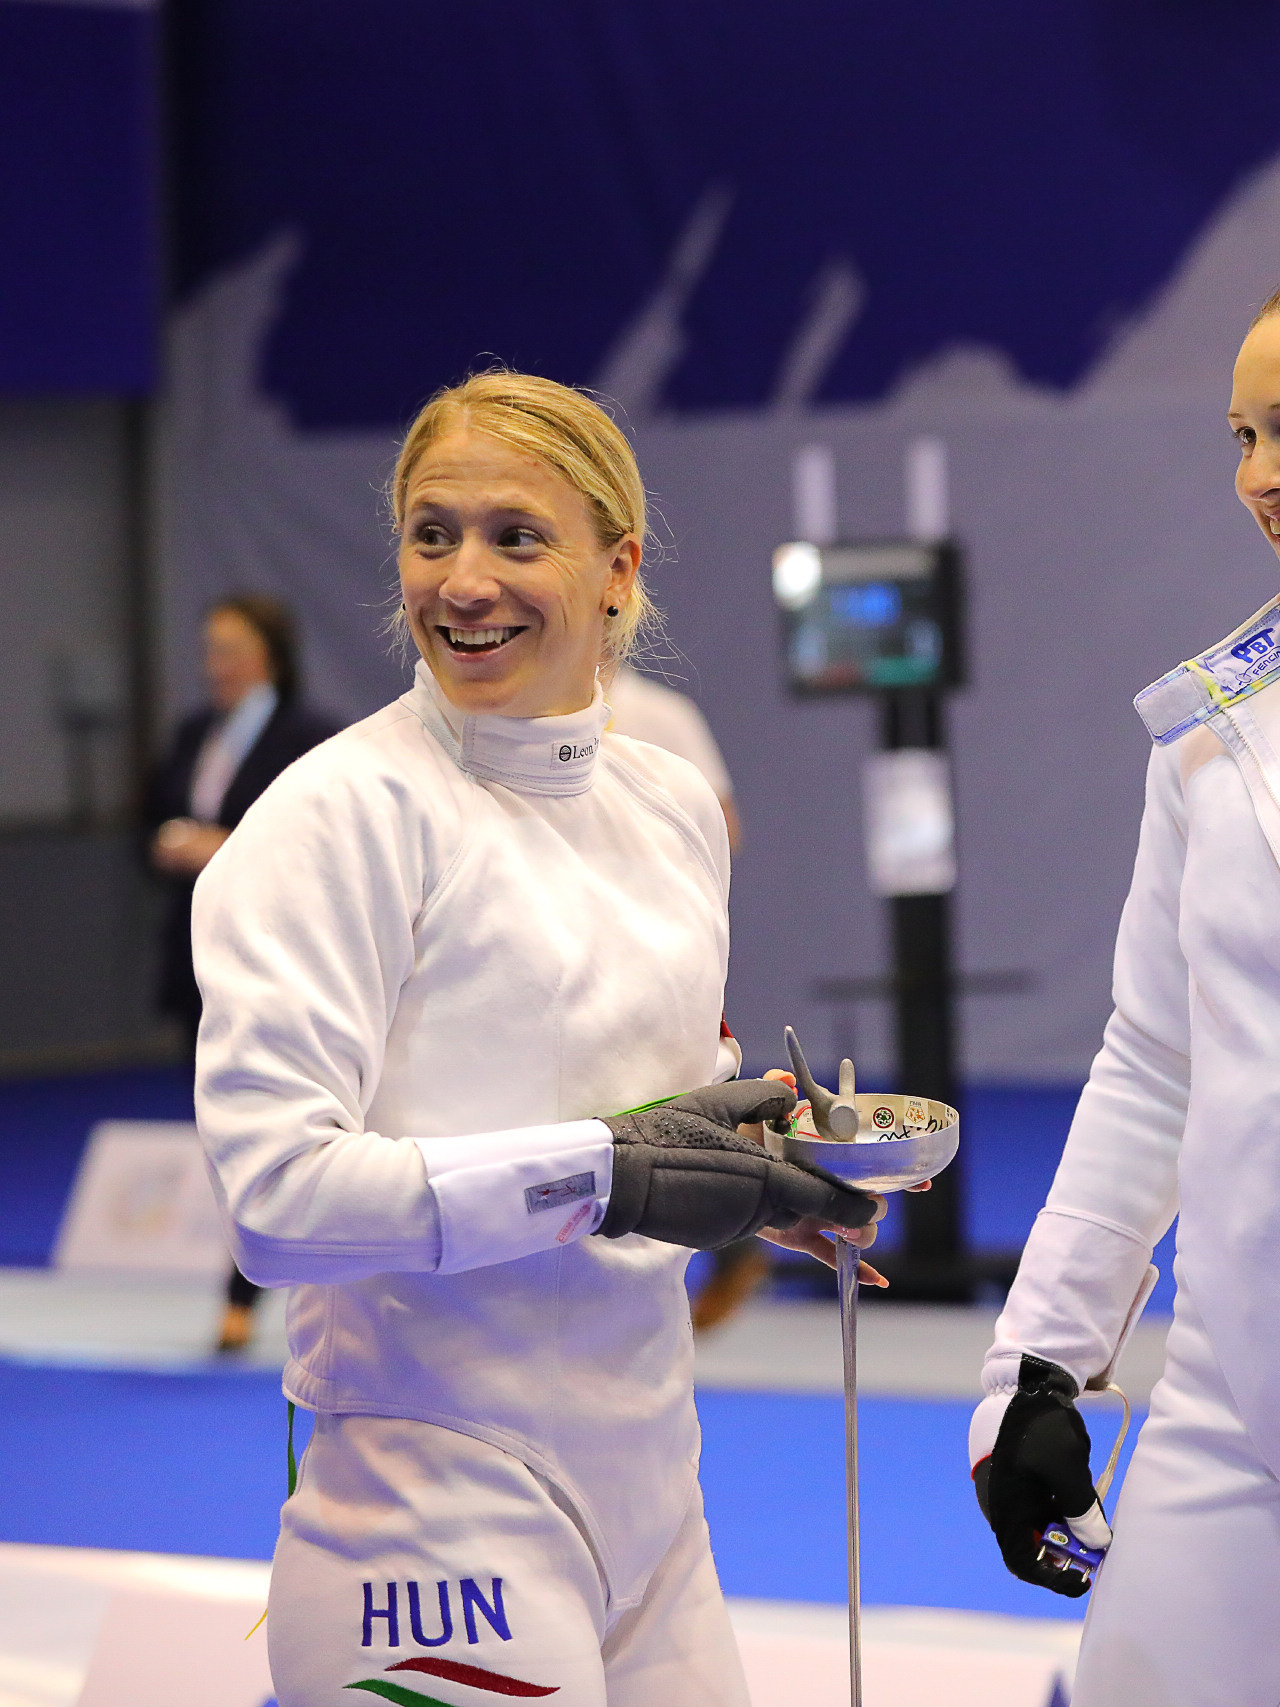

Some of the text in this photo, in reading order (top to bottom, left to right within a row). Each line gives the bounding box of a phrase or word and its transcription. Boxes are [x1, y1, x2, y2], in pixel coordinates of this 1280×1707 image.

[1230, 627, 1276, 664] PBT
[573, 745, 594, 759] Leon
[360, 1577, 514, 1648] HUN
